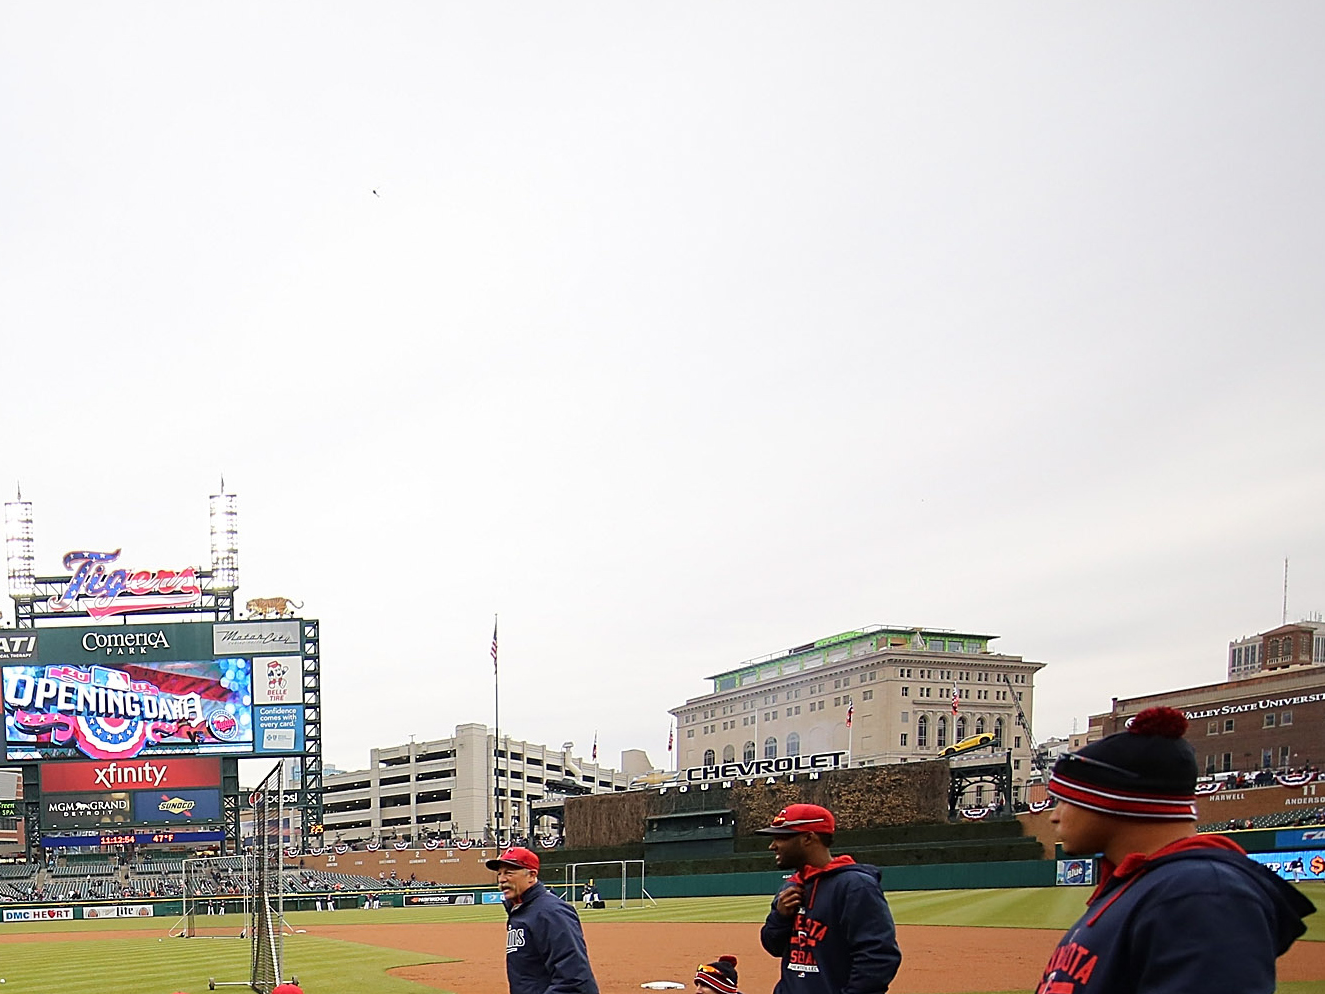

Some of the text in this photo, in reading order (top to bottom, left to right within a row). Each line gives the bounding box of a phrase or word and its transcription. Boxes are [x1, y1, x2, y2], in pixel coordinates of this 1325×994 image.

[48, 548, 202, 621] Tigers
[106, 646, 147, 655] PARK
[5, 674, 141, 717] OPENING
[267, 688, 288, 696] BELLE
[259, 707, 297, 715] Confidence
[1221, 703, 1258, 715] STATE
[686, 750, 849, 782] CHEVROLET
[94, 761, 167, 789] xfinity
[659, 772, 819, 795] FOUNTAIN
[1302, 785, 1316, 796] 11
[1209, 793, 1245, 802] HARWELL
[48, 800, 127, 812] MGM GRAND
[160, 801, 194, 810] SUNOCO
[100, 835, 136, 844] 11:12:54
[1067, 867, 1083, 879] Blue
[6, 911, 29, 920] DMC
